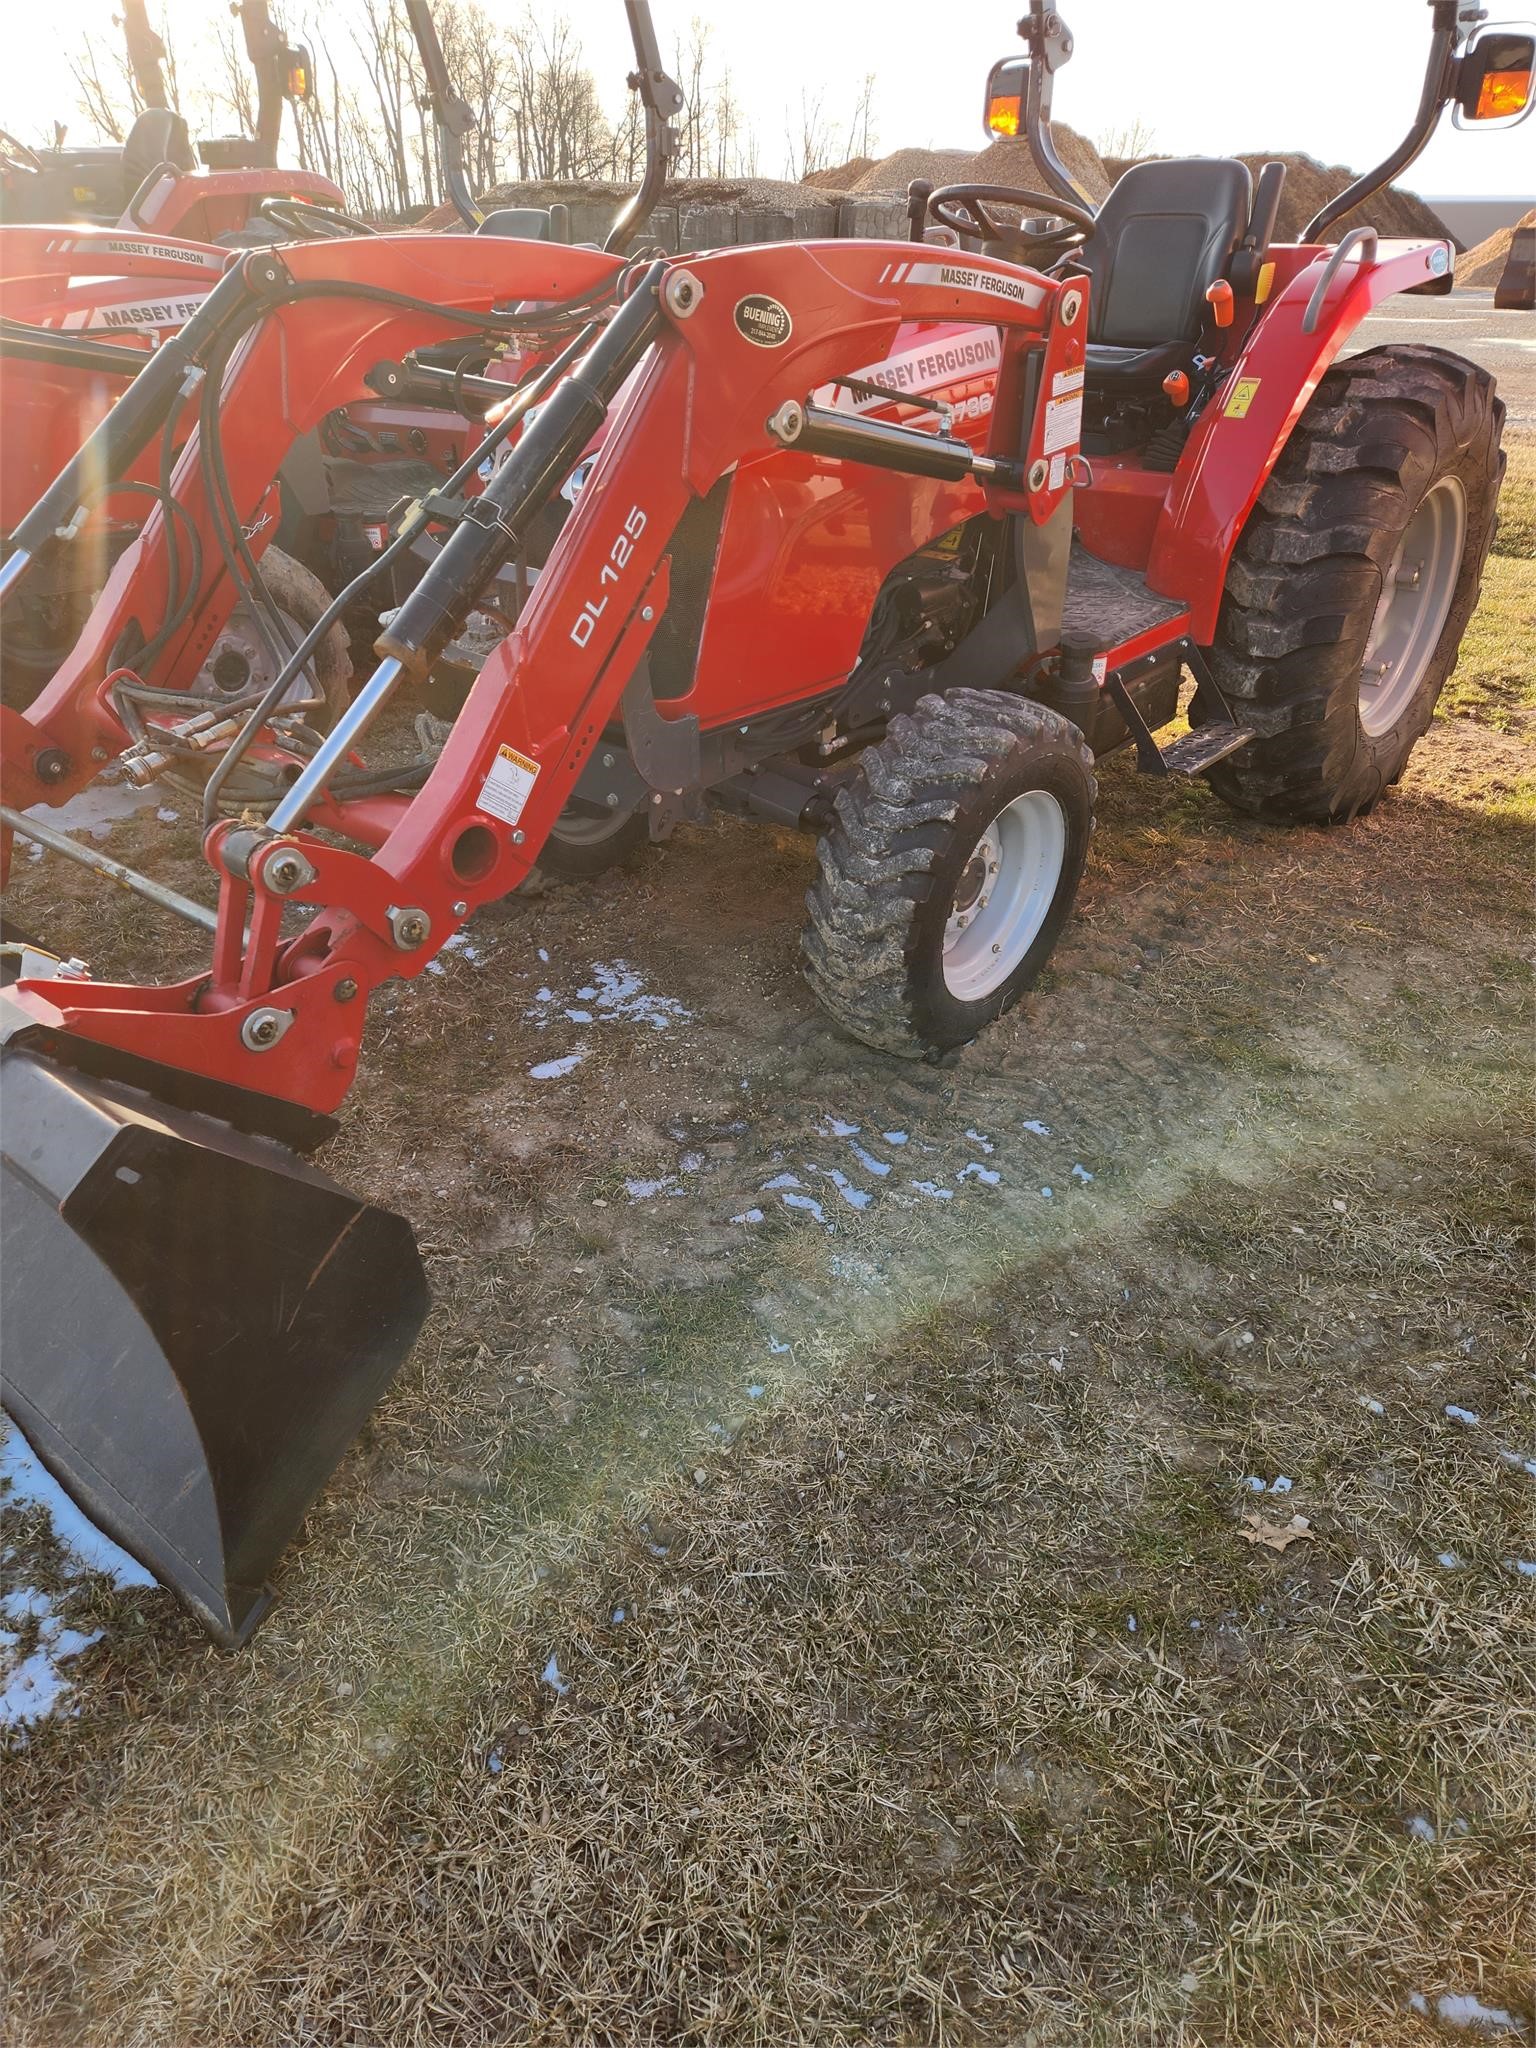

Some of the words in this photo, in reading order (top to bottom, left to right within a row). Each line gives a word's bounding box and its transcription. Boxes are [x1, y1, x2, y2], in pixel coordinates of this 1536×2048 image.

[108, 242, 151, 255] MASSEY
[153, 246, 204, 264] FERGUSON
[941, 268, 978, 287] MASSEY
[980, 275, 1025, 300] FERGUSON
[102, 305, 173, 327] MASSEY
[743, 305, 781, 327] BUENING
[918, 339, 996, 380] FERGUSON
[570, 595, 608, 648] DL
[600, 505, 647, 584] 125
[507, 754, 538, 774] WARNING
